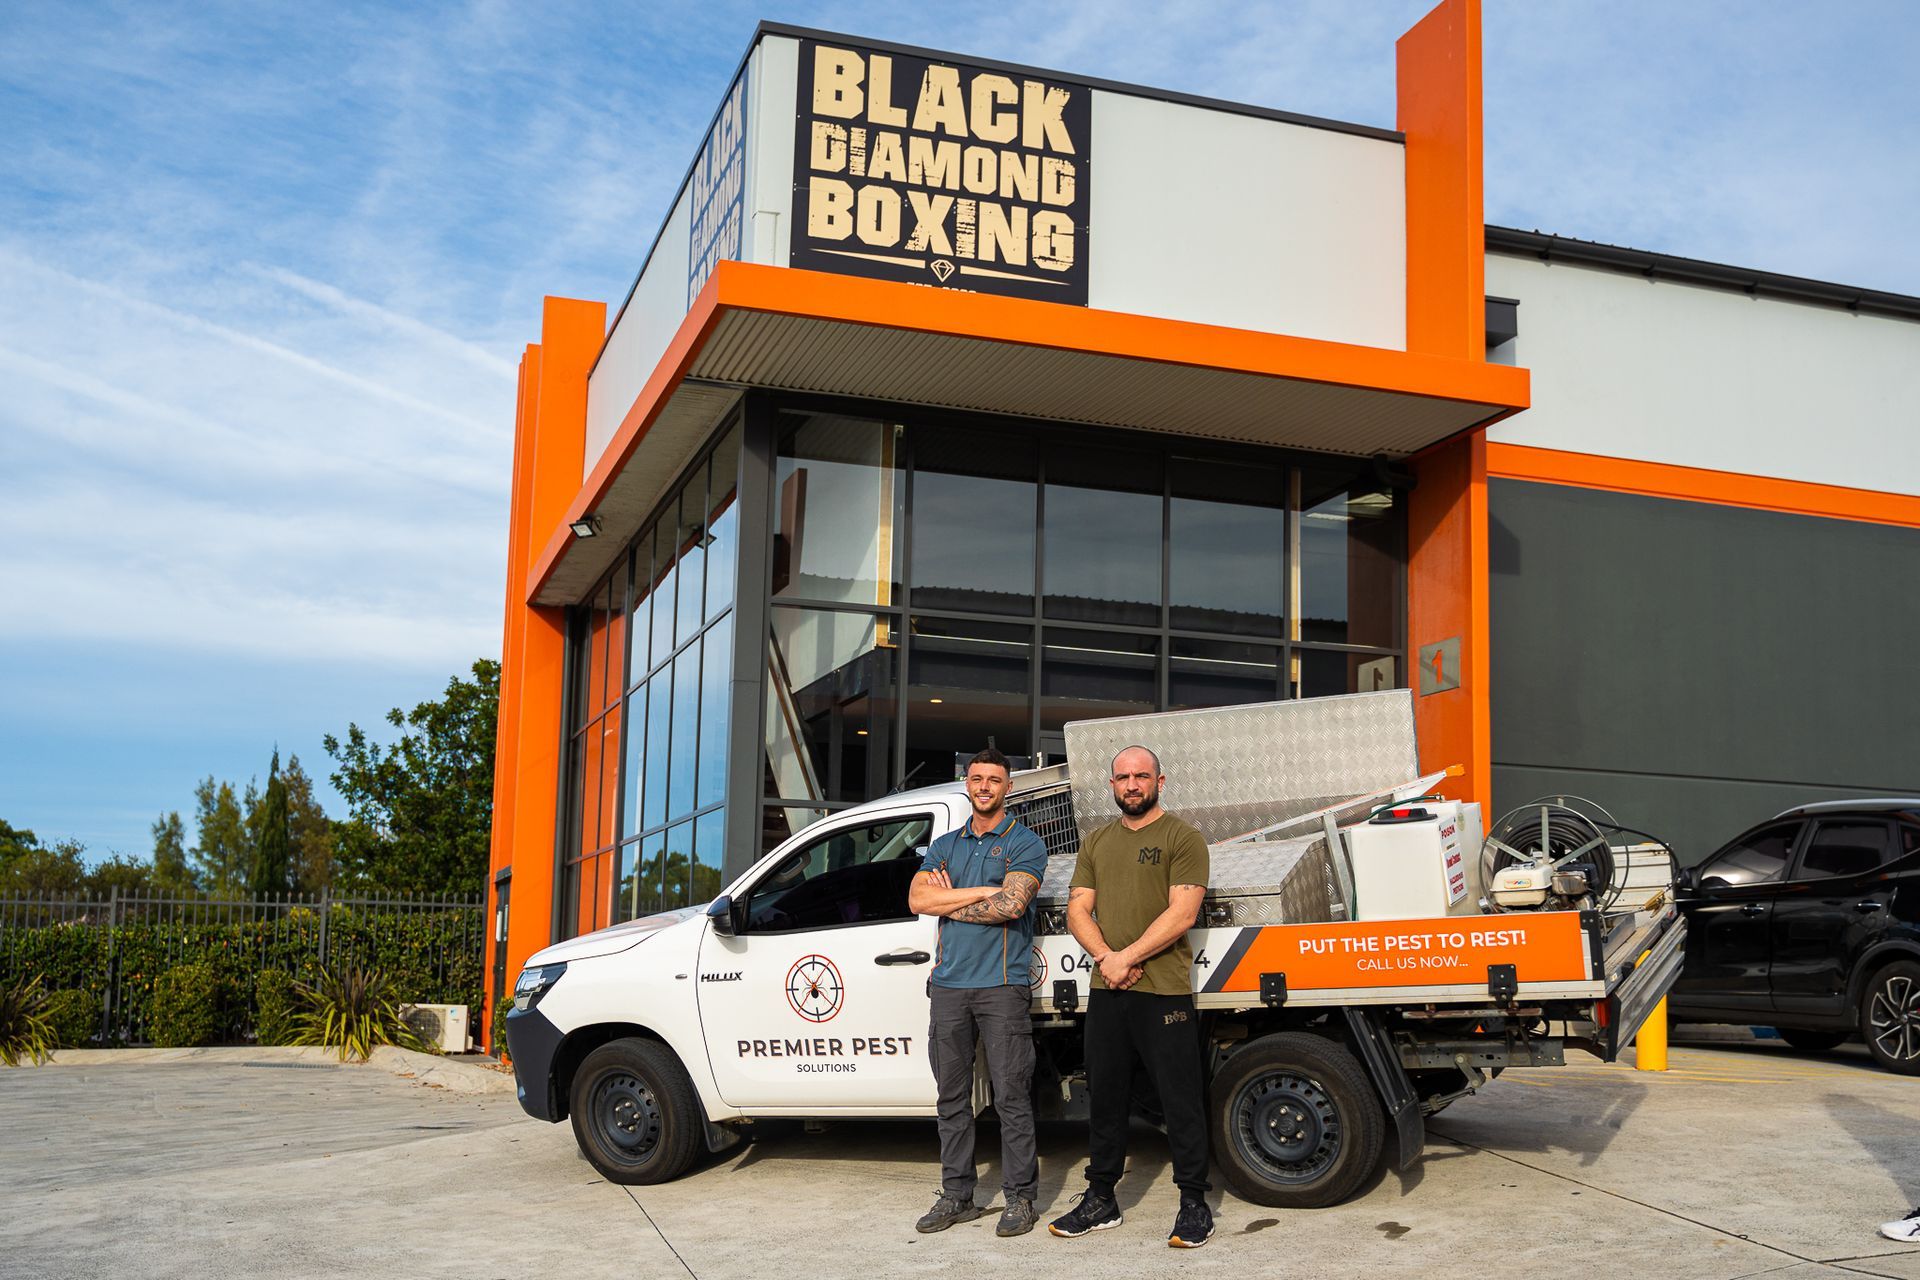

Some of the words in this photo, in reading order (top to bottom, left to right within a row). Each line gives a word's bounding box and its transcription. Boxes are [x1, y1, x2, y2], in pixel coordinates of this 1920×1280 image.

[812, 45, 1076, 155] BLACK
[692, 78, 744, 228] BLACK
[809, 120, 1076, 207] DIAMOND
[690, 146, 742, 276] DIAMOND
[807, 176, 1076, 272] BOXING
[1431, 649, 1443, 684] 1
[1298, 938, 1336, 954] PUT
[1340, 936, 1379, 953] THE
[1384, 934, 1433, 951] PEST
[1436, 932, 1465, 948] TO
[1470, 930, 1527, 947] REST!
[701, 971, 743, 982] HILUX
[1356, 957, 1393, 971] CALL
[1397, 956, 1417, 970] US
[737, 1038, 844, 1058] PREMIER
[853, 1037, 913, 1056] PEST
[796, 1063, 857, 1073] SOLUTIONS
